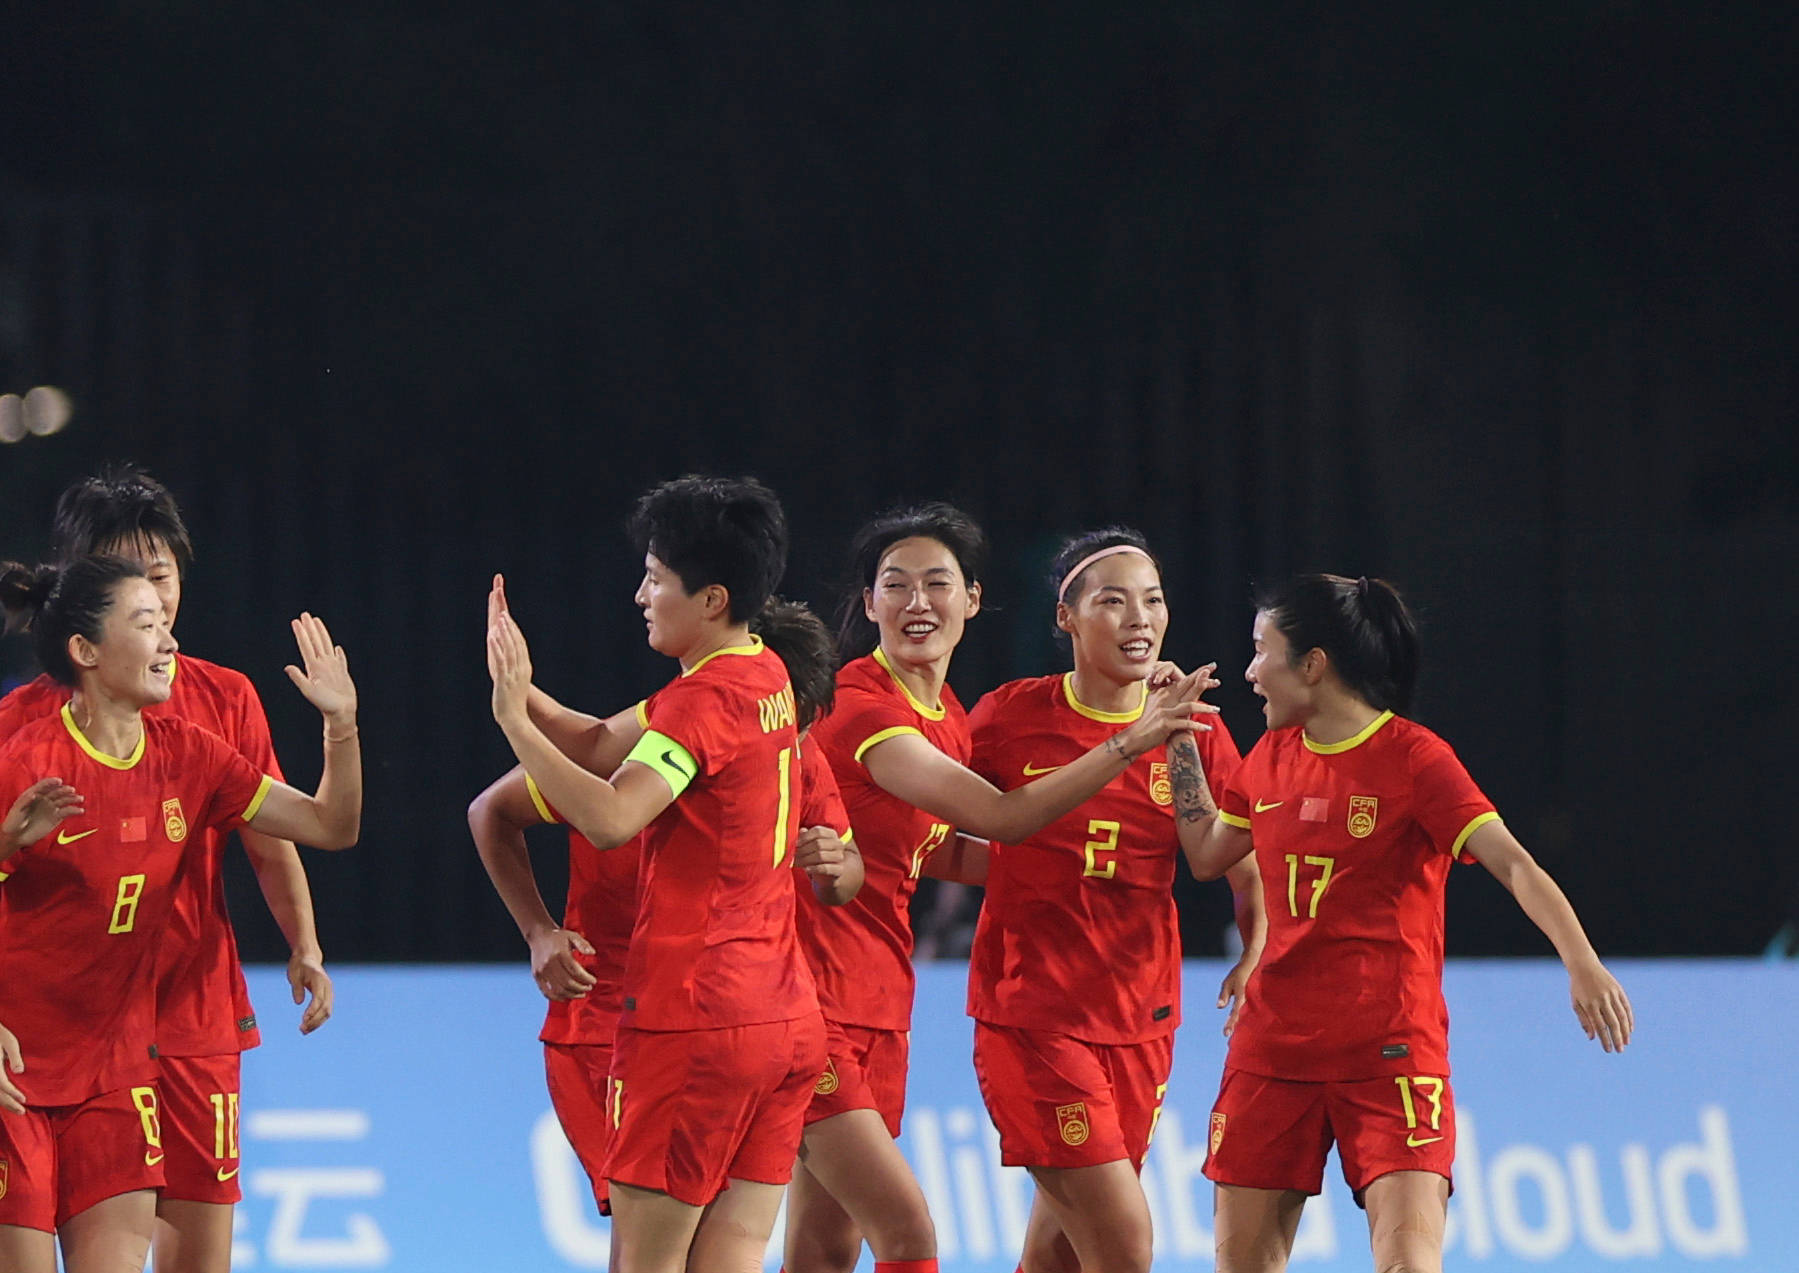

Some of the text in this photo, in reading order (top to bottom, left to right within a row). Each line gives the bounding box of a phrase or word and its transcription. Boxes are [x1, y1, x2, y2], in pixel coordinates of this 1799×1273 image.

[1083, 819, 1120, 879] 2
[108, 874, 145, 934] 8
[1285, 854, 1334, 918] 17
[129, 1087, 161, 1148] 8
[1395, 1077, 1444, 1130] 17
[1443, 1105, 1749, 1262] loud
